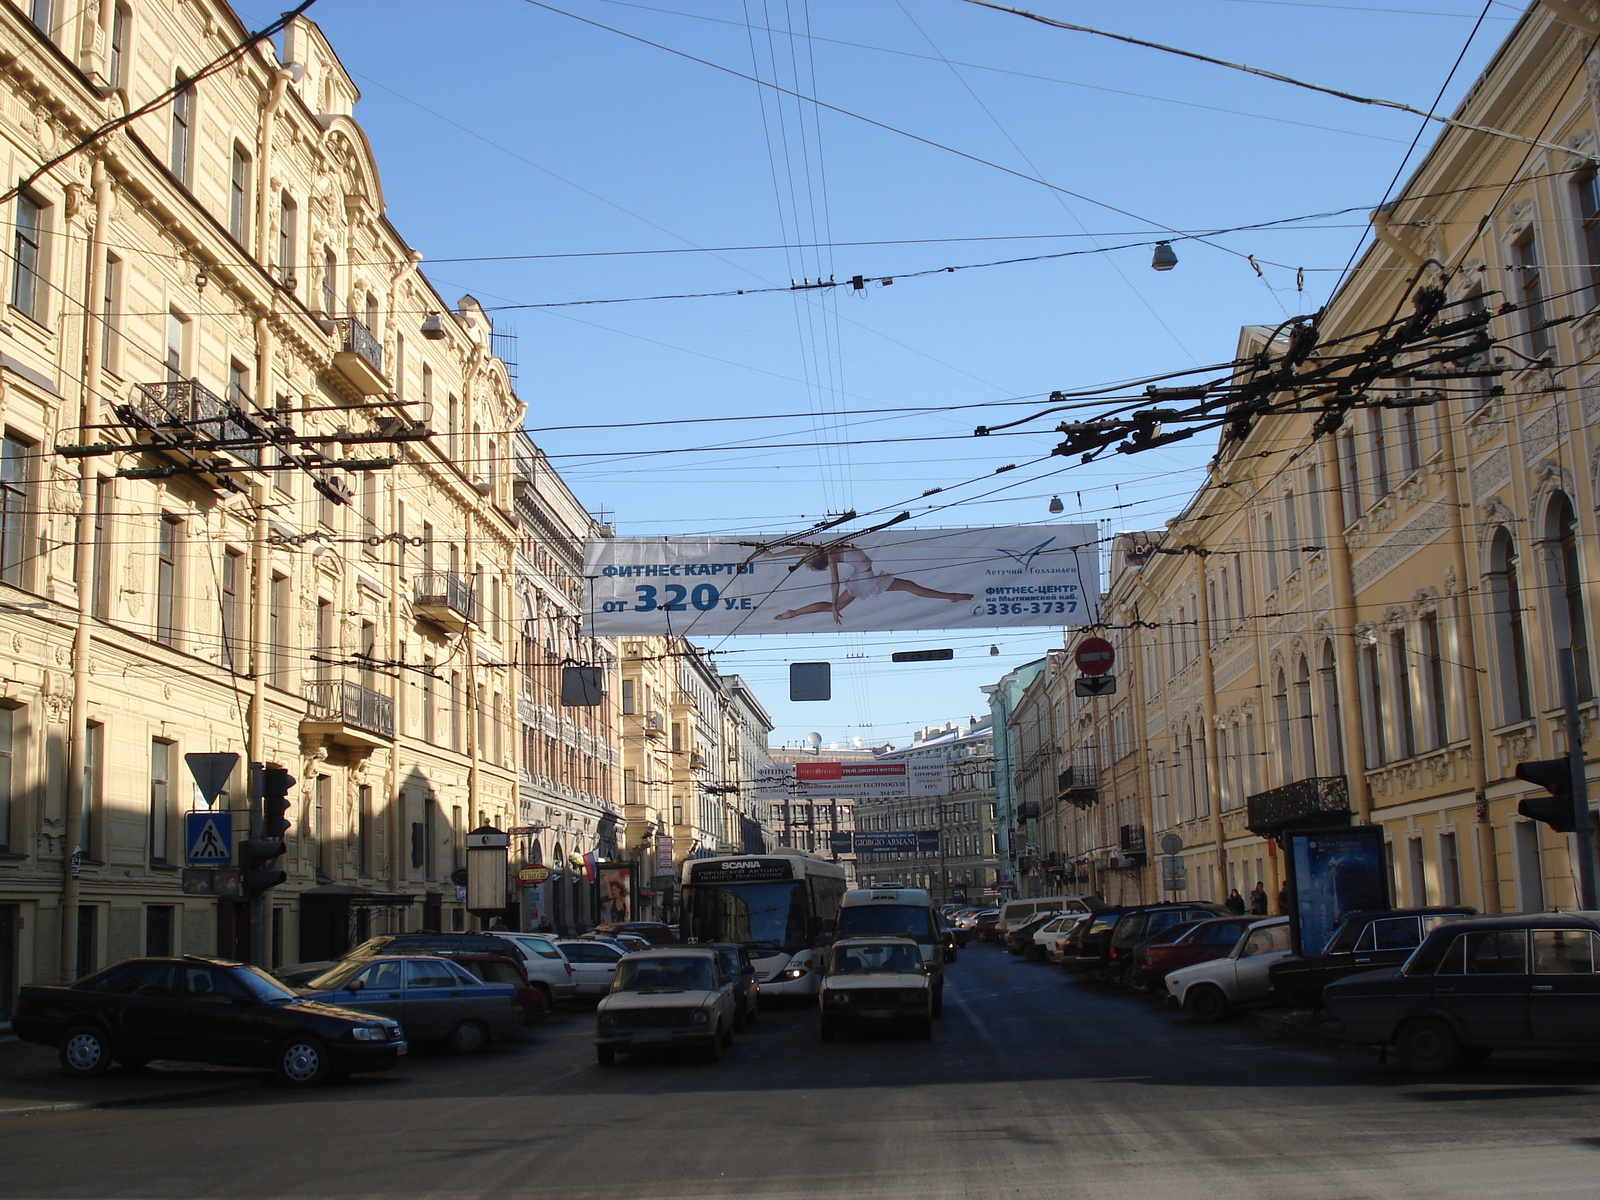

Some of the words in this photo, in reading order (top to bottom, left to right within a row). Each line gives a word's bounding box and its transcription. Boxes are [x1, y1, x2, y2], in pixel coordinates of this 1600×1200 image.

[602, 565, 681, 578] ФИТНЕС
[685, 563, 754, 577] КАРТЫ
[985, 567, 1023, 578] Летучий
[1029, 566, 1077, 575] Голландец
[985, 584, 1078, 595] ФИТНЕС-ЦЕНТР
[634, 583, 720, 612] 320
[724, 598, 757, 611] У.Е.
[987, 601, 1078, 615] 336-3737
[863, 780, 906, 788] TECHNOGYM
[855, 838, 885, 847] GIORGIO
[886, 837, 916, 846] ARMANI
[721, 861, 761, 870] SCANIA
